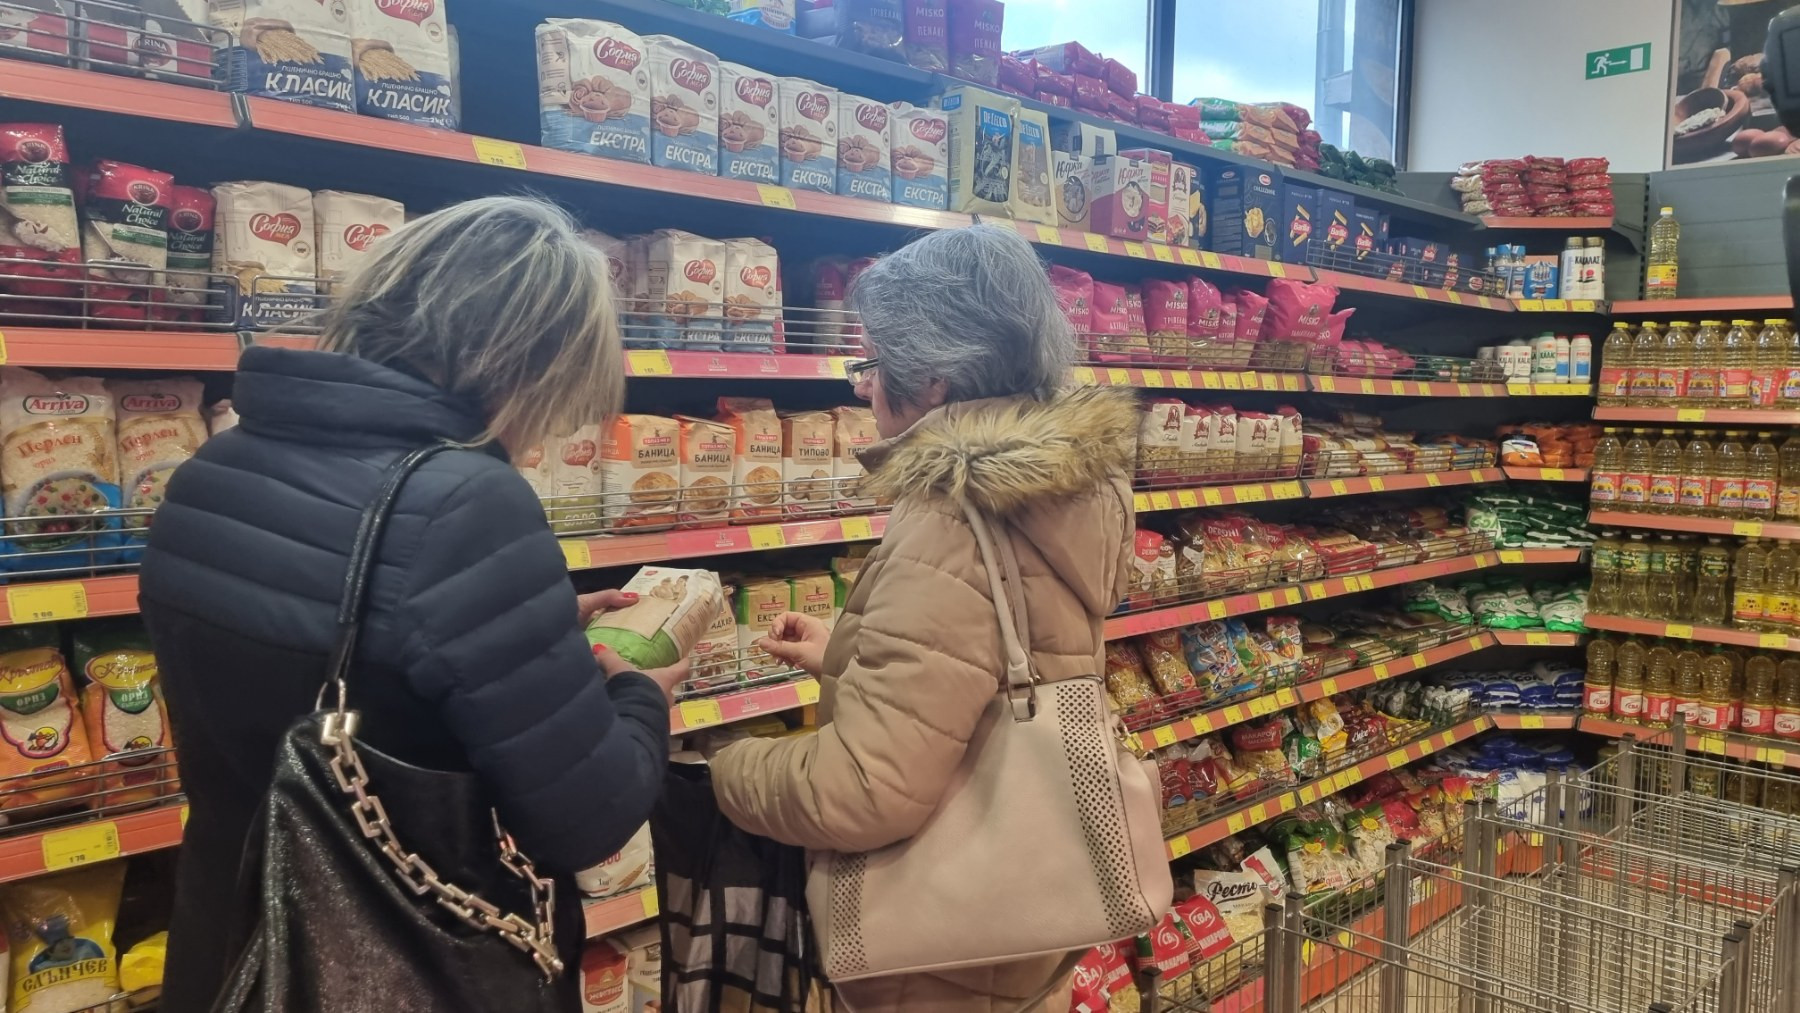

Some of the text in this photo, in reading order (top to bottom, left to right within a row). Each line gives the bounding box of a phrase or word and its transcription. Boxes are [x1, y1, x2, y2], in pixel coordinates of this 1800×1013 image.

[916, 6, 944, 18] MISKO
[974, 20, 1000, 33] MISKO
[138, 37, 167, 50] RINA
[596, 36, 639, 64] София
[671, 59, 707, 86] София
[265, 72, 353, 101] КЛАСИК
[736, 77, 771, 101] София
[366, 89, 451, 116] КЛАСИК
[797, 94, 827, 119] София
[857, 105, 886, 125] София
[911, 121, 945, 138] София
[590, 131, 646, 153] ЕКСТРА
[666, 145, 712, 169] ЕКСТРА
[15, 164, 61, 175] Natural
[730, 160, 774, 179] ЕКСТРА
[22, 174, 58, 185] Choice
[792, 169, 832, 189] ЕКСТРА
[850, 180, 889, 198] ЕКСТРА
[904, 186, 944, 204] ЕКСТРА
[121, 203, 163, 218] Natural
[126, 213, 158, 228] Choice
[252, 214, 295, 238] София
[169, 230, 206, 242] Natural
[346, 226, 378, 248] Соф
[170, 240, 202, 252] Choice
[685, 260, 715, 279] София
[740, 267, 769, 282] София
[1069, 307, 1089, 315] MISKO
[1299, 315, 1320, 325] MISKO
[28, 398, 85, 411] Arriva
[125, 397, 177, 410] Arriva
[17, 433, 83, 458] Перлен
[750, 444, 781, 454] БАНИЦА
[799, 447, 829, 456] ТИПОВО
[638, 450, 676, 459] БАНИЦА
[694, 454, 731, 463] БАНИЦА
[804, 604, 830, 614] ЕКСТРА
[1207, 880, 1258, 901] Рести
[1193, 910, 1213, 926] CBA
[1101, 945, 1114, 957] BA
[22, 959, 108, 991] СЛЪНЧЕВ
[1075, 970, 1100, 988] CBA
